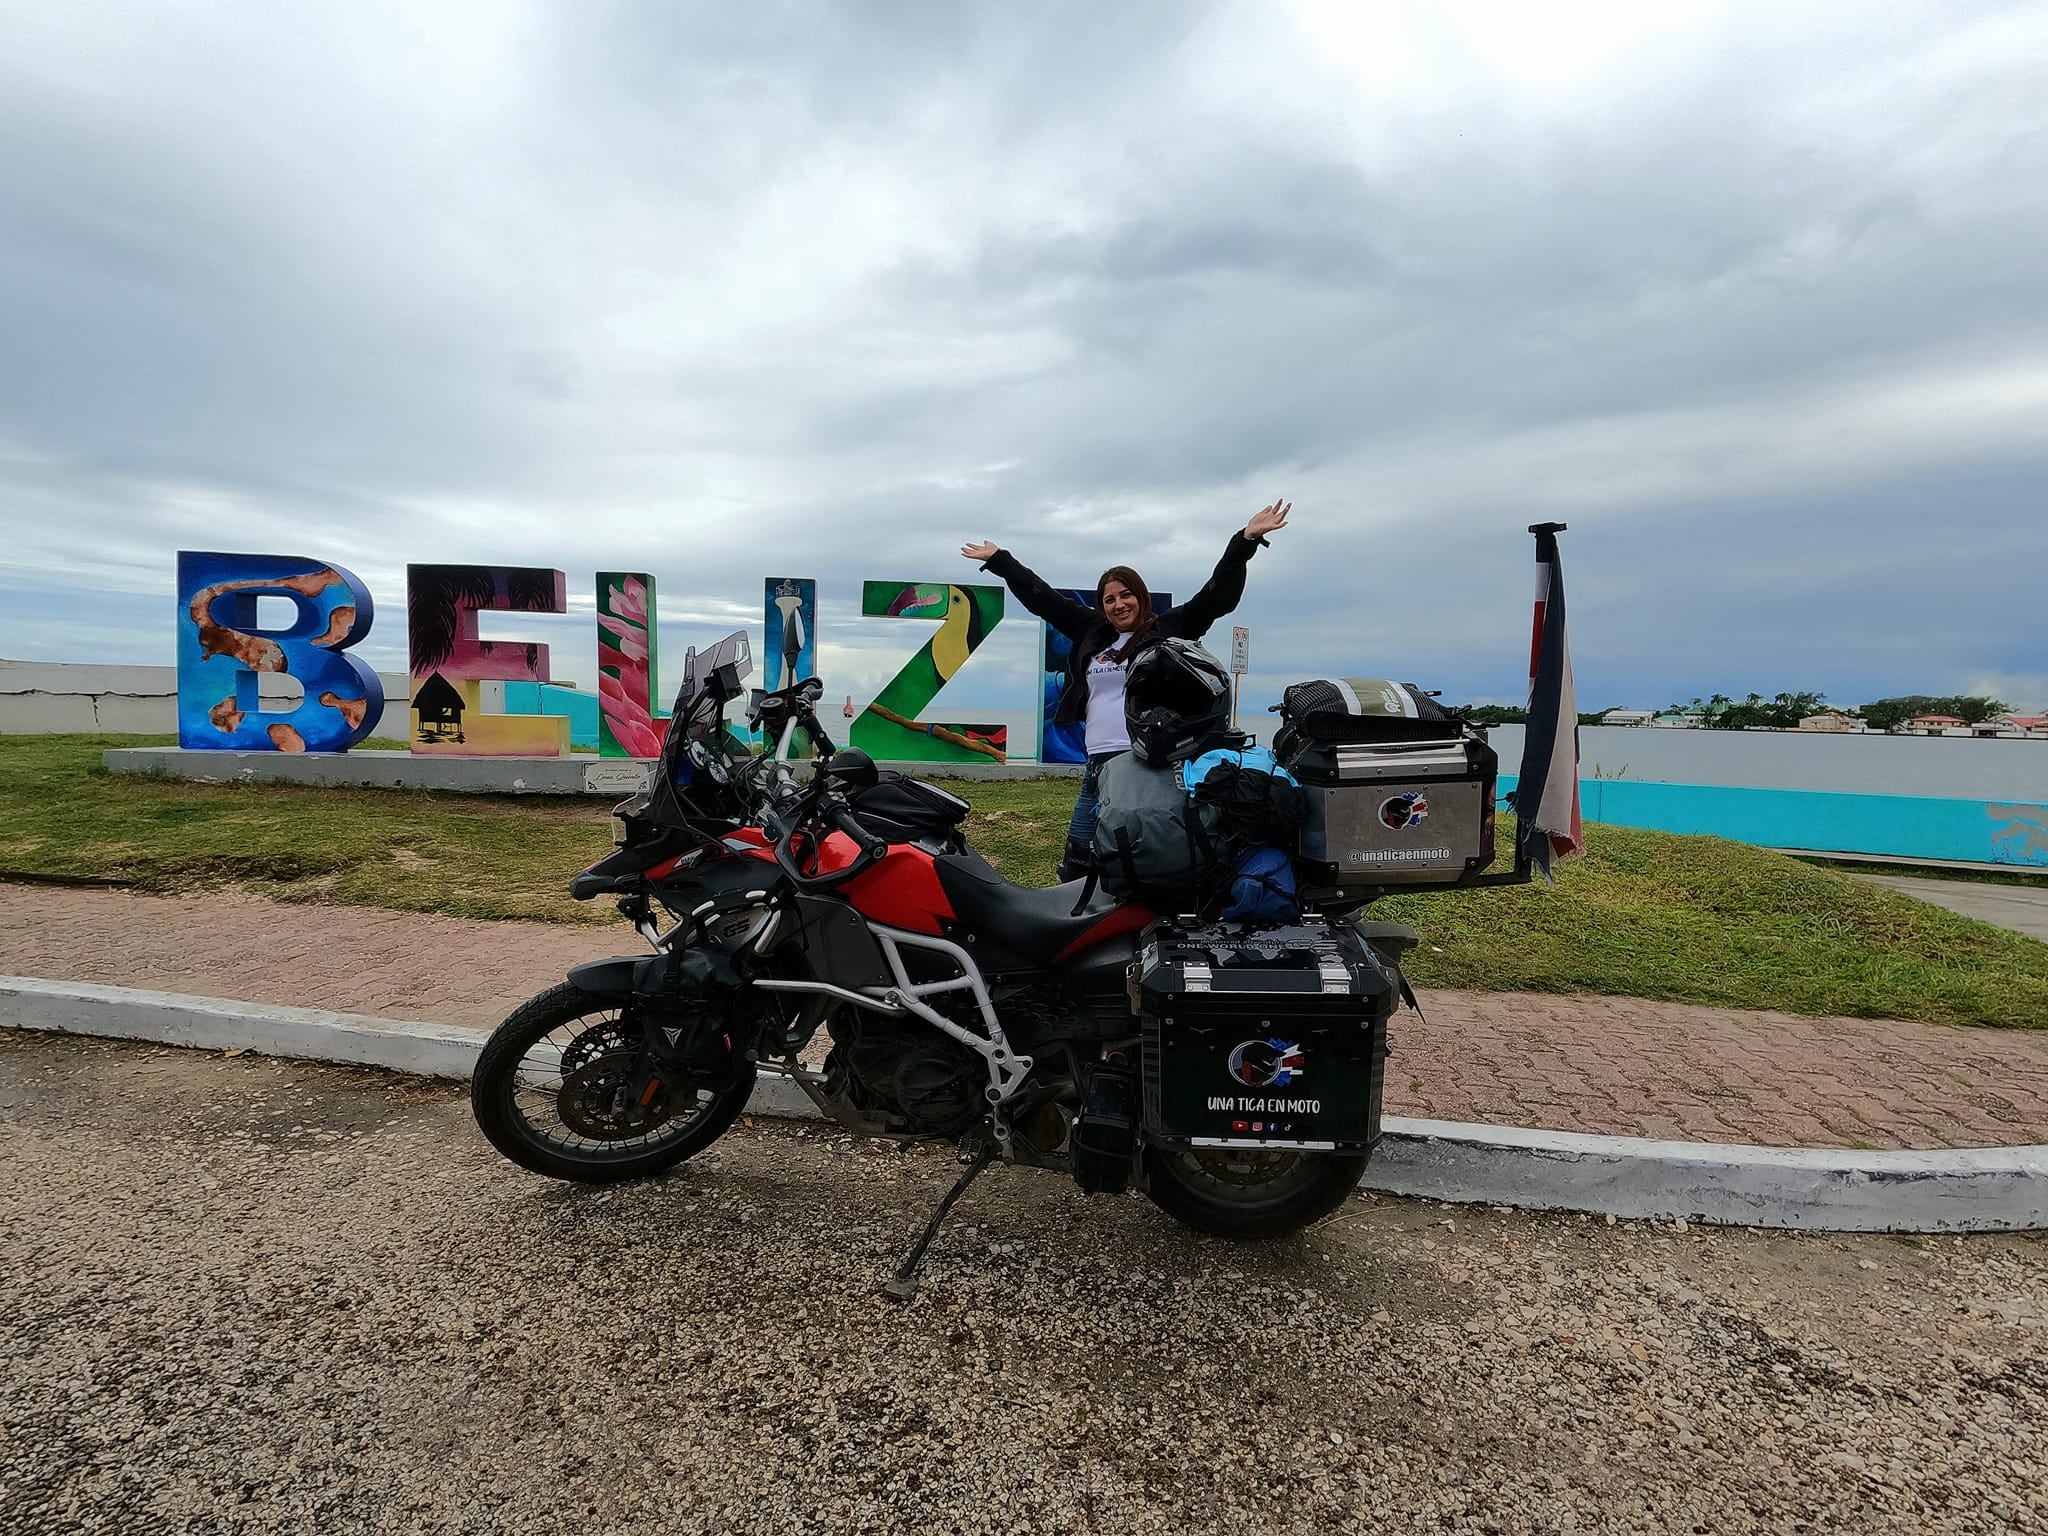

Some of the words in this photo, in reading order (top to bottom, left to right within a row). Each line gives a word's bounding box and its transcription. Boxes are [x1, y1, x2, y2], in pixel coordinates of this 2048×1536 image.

[1348, 848, 1451, 864] @unaticaenmoto
[1207, 1096, 1235, 1111] UNA
[1237, 1097, 1265, 1112] TICA
[1267, 1099, 1285, 1113] EN
[1287, 1099, 1321, 1114] MOTO
